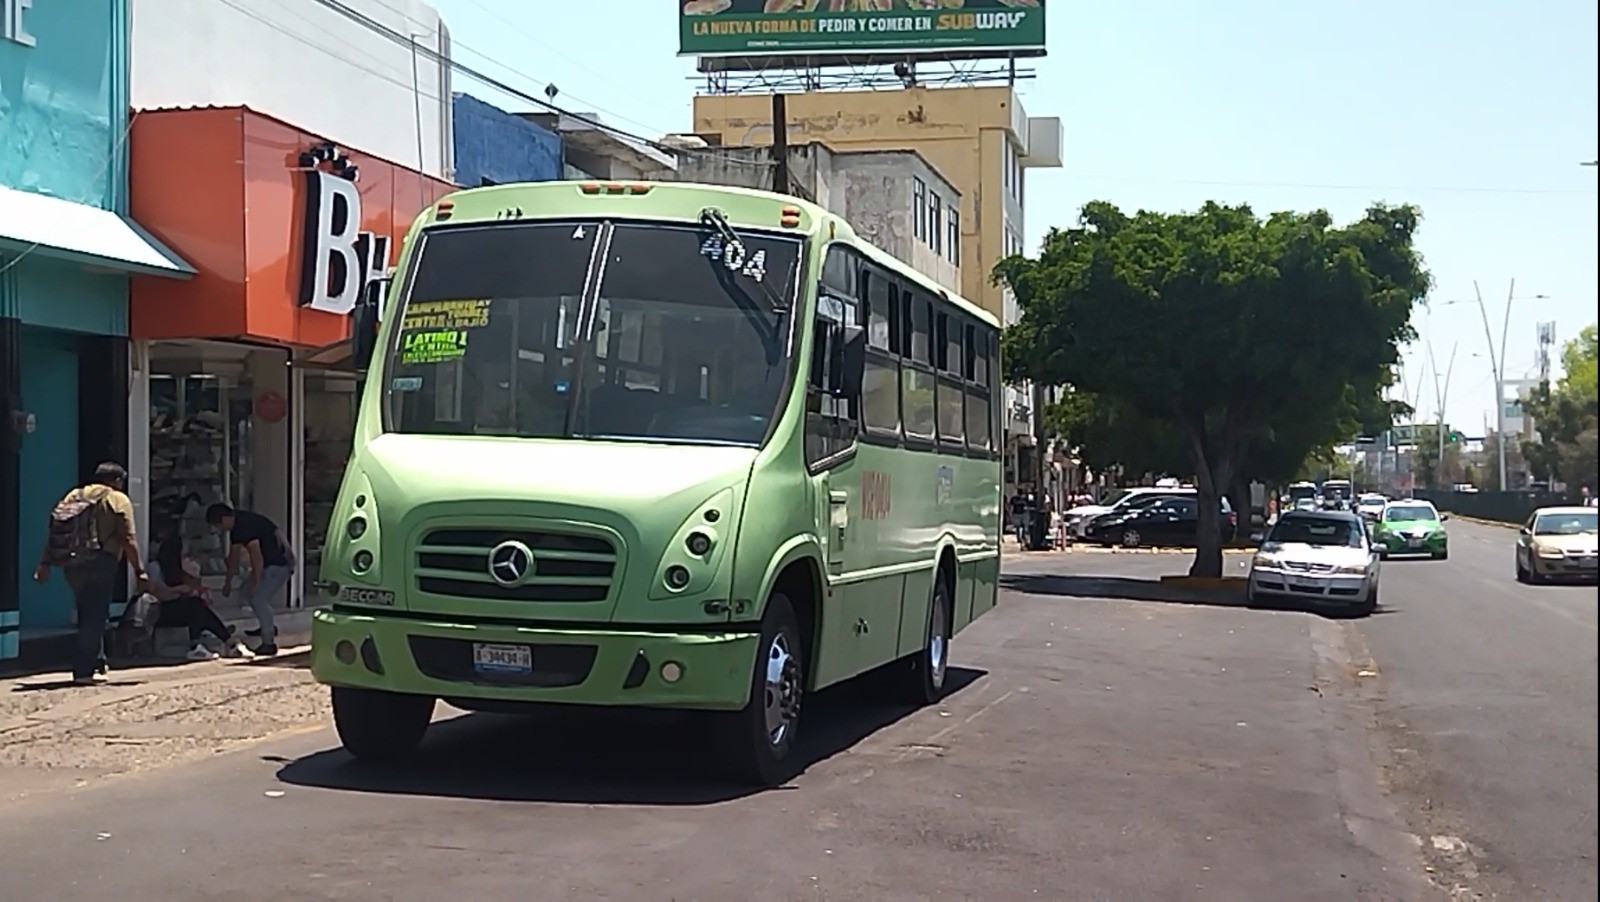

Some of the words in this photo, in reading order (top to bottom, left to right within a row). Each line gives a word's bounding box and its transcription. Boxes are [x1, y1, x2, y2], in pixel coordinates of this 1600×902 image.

[693, 22, 710, 36] LA
[710, 20, 753, 35] NUEVA
[754, 19, 798, 34] FORMA
[800, 19, 816, 33] DE
[818, 18, 856, 33] PEDIR
[858, 18, 868, 32] Y
[868, 17, 913, 32] COMER
[915, 16, 932, 31] EN
[936, 11, 1026, 31] SUBWAY
[340, 588, 394, 605] BECCAR
